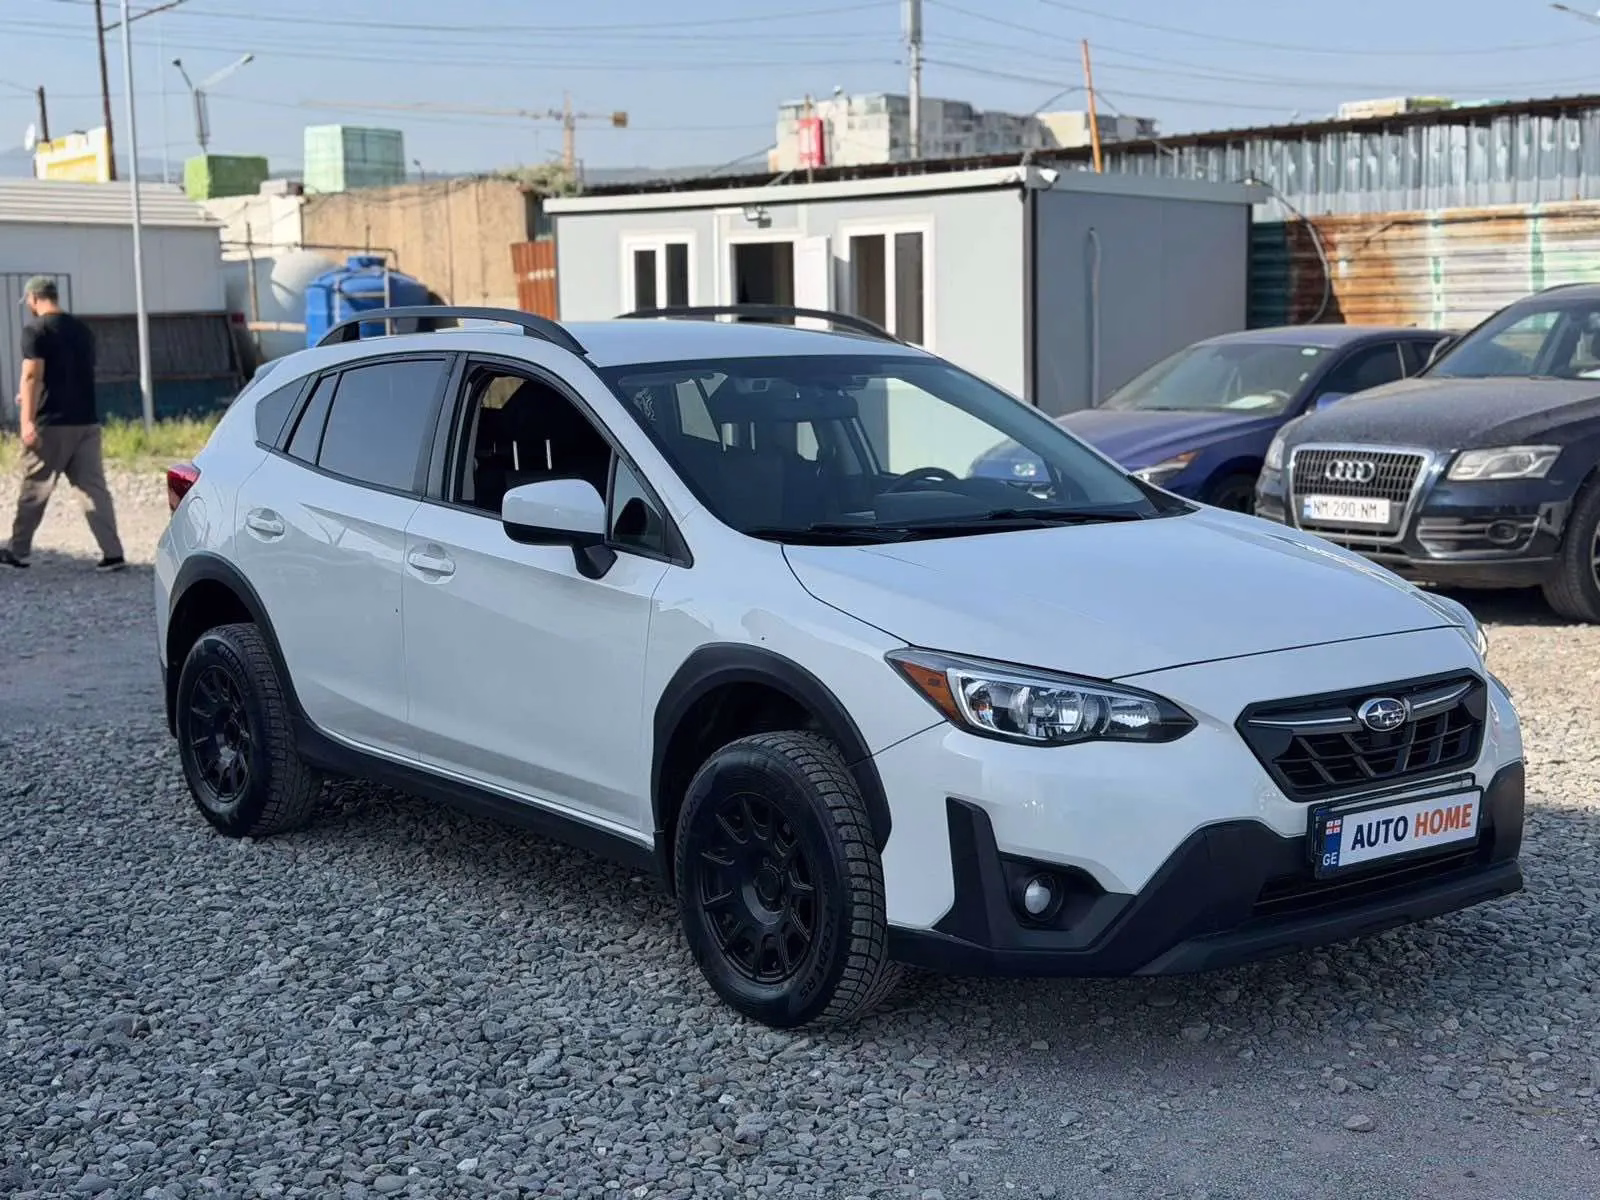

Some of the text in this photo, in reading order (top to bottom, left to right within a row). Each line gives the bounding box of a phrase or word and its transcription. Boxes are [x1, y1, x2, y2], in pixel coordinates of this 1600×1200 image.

[1333, 502, 1356, 517] 290
[1351, 803, 1473, 850] AUTO HOME
[1322, 852, 1338, 866] GE
